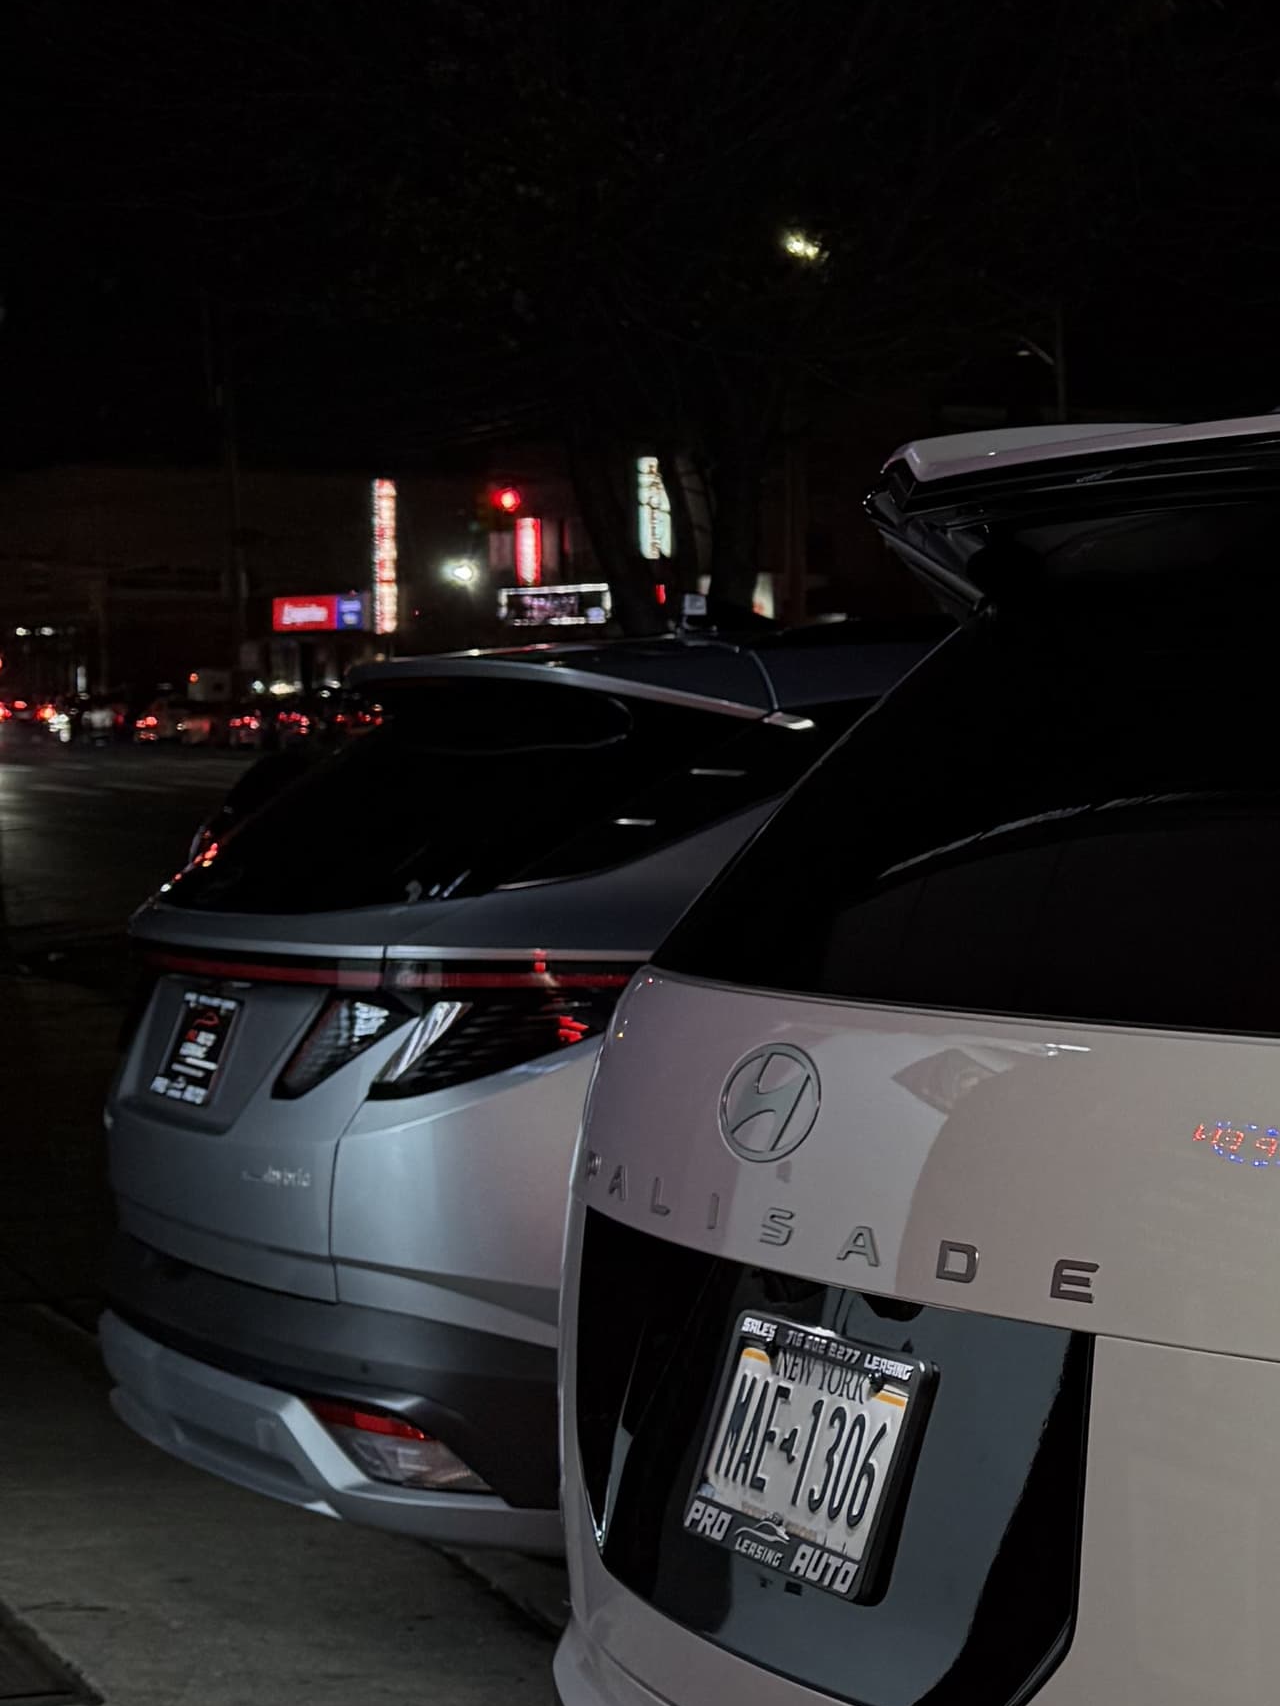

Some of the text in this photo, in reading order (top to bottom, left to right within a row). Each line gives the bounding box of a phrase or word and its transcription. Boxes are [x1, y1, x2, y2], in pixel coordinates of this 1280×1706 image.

[583, 1149, 1100, 1304] PALISADE
[742, 1317, 777, 1339] SALES
[864, 1354, 914, 1381] LEASING
[775, 1349, 867, 1404] NEW YORK
[684, 1499, 733, 1541] PRO
[734, 1536, 784, 1568] LEASING
[789, 1543, 859, 1593] AUTO
